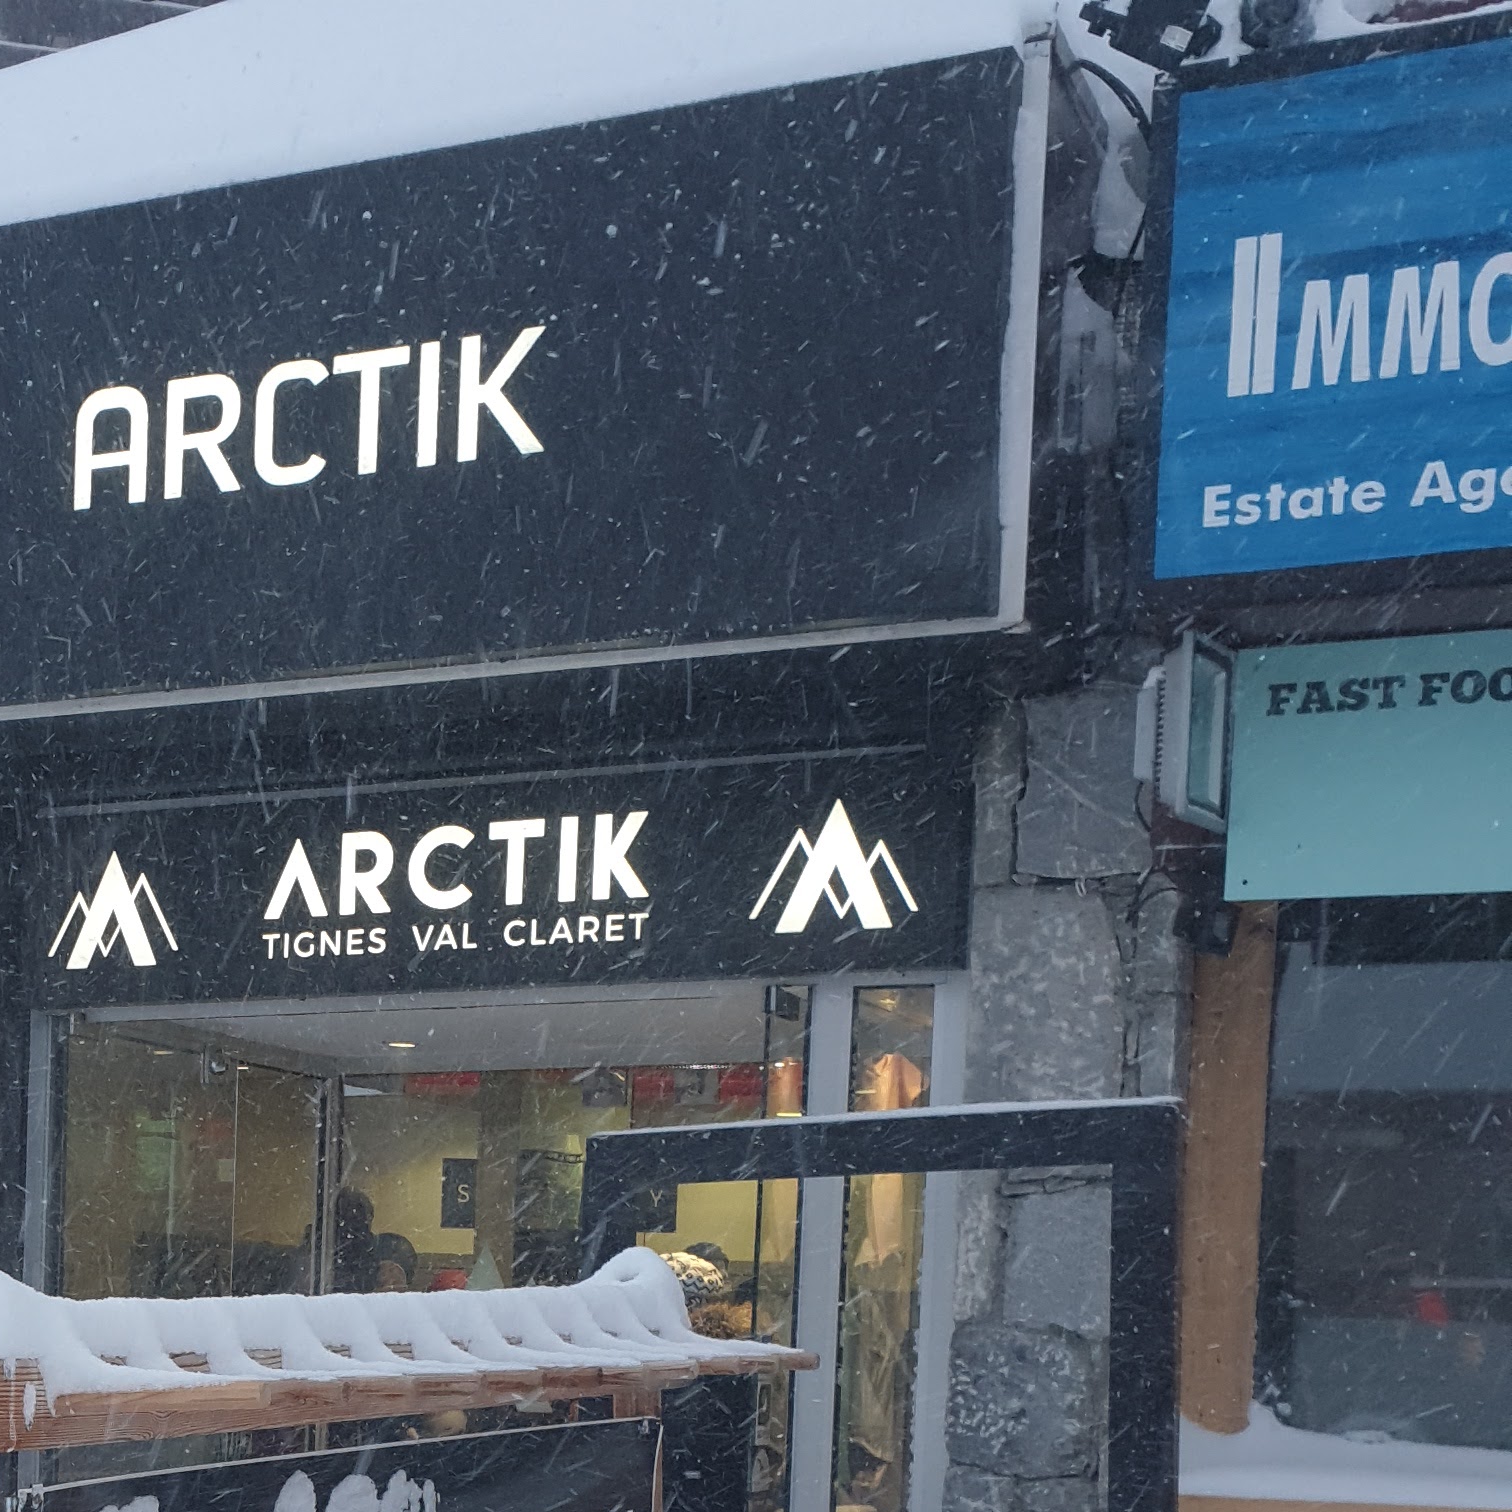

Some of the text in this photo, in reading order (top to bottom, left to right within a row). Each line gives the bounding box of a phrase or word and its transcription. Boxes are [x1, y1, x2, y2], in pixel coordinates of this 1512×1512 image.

[74, 326, 546, 511] ARCTIK
[1201, 473, 1385, 528] Estate
[1266, 674, 1406, 717] FAST
[264, 811, 651, 922] ARCTIK
[262, 912, 651, 961] TIGNES VAL CLARET
